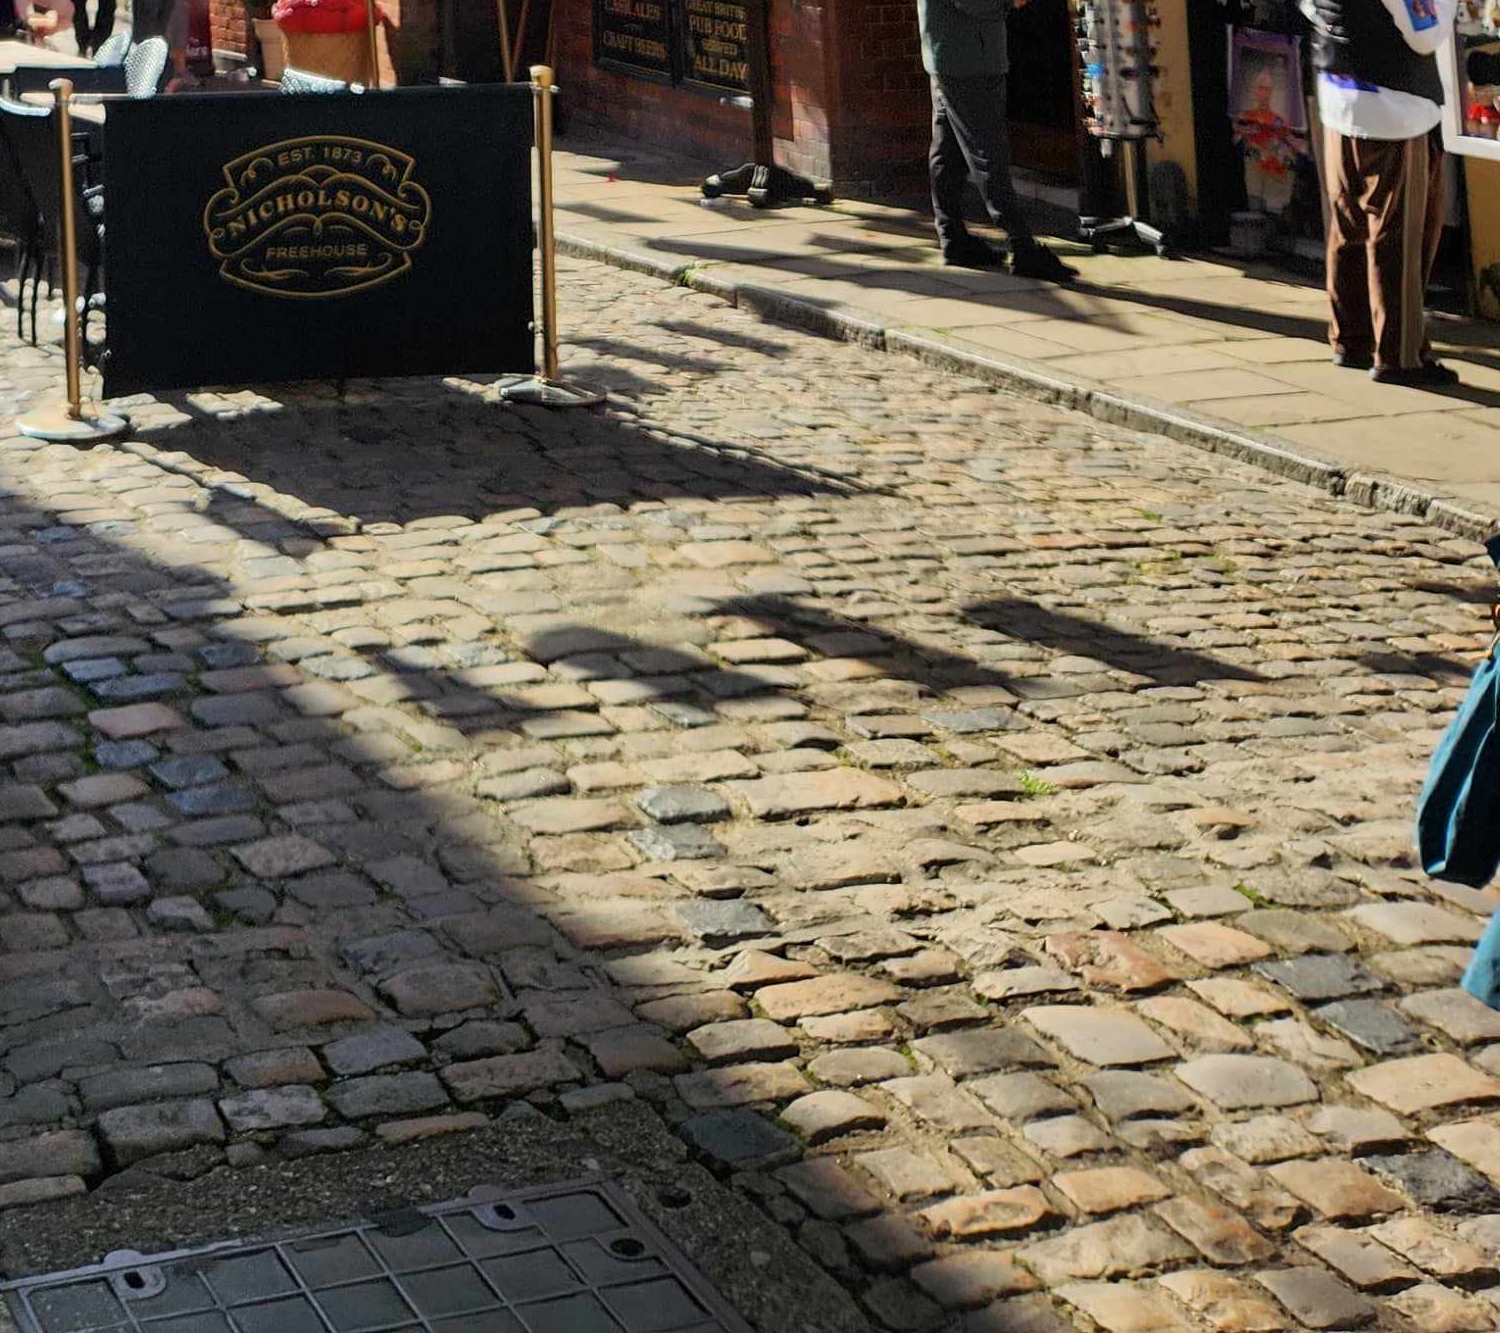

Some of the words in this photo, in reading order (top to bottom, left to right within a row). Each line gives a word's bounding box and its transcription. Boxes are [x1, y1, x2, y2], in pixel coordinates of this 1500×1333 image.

[719, 58, 750, 81] DAY
[276, 146, 315, 167] EST.
[322, 146, 364, 164] 1873
[227, 188, 410, 238] NICHOLSON'S
[265, 243, 370, 262] FREEHOUSE
